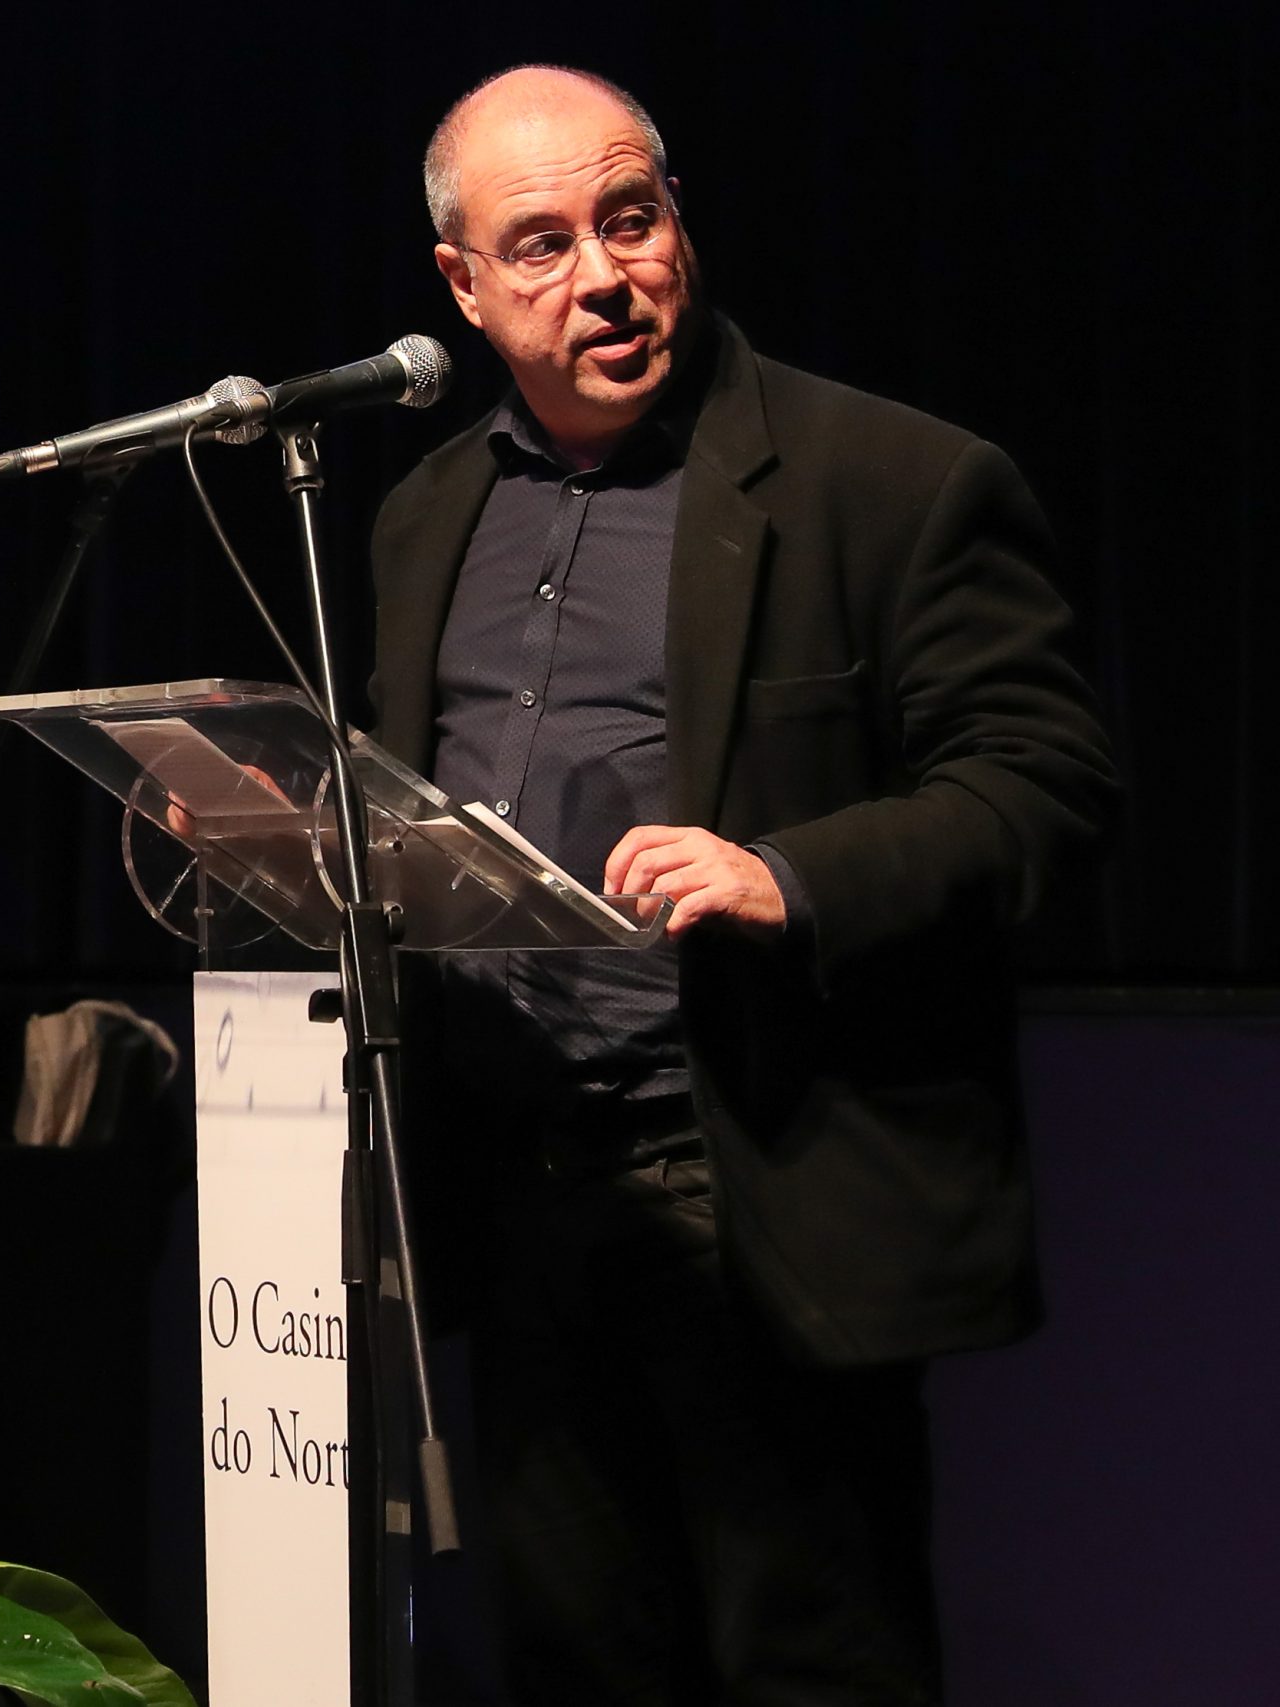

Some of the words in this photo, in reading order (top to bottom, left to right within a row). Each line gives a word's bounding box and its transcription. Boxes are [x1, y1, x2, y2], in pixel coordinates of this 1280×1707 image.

[209, 1277, 238, 1348] O
[251, 1281, 347, 1361] Casin
[211, 1397, 251, 1474] do
[267, 1407, 349, 1490] Nort
